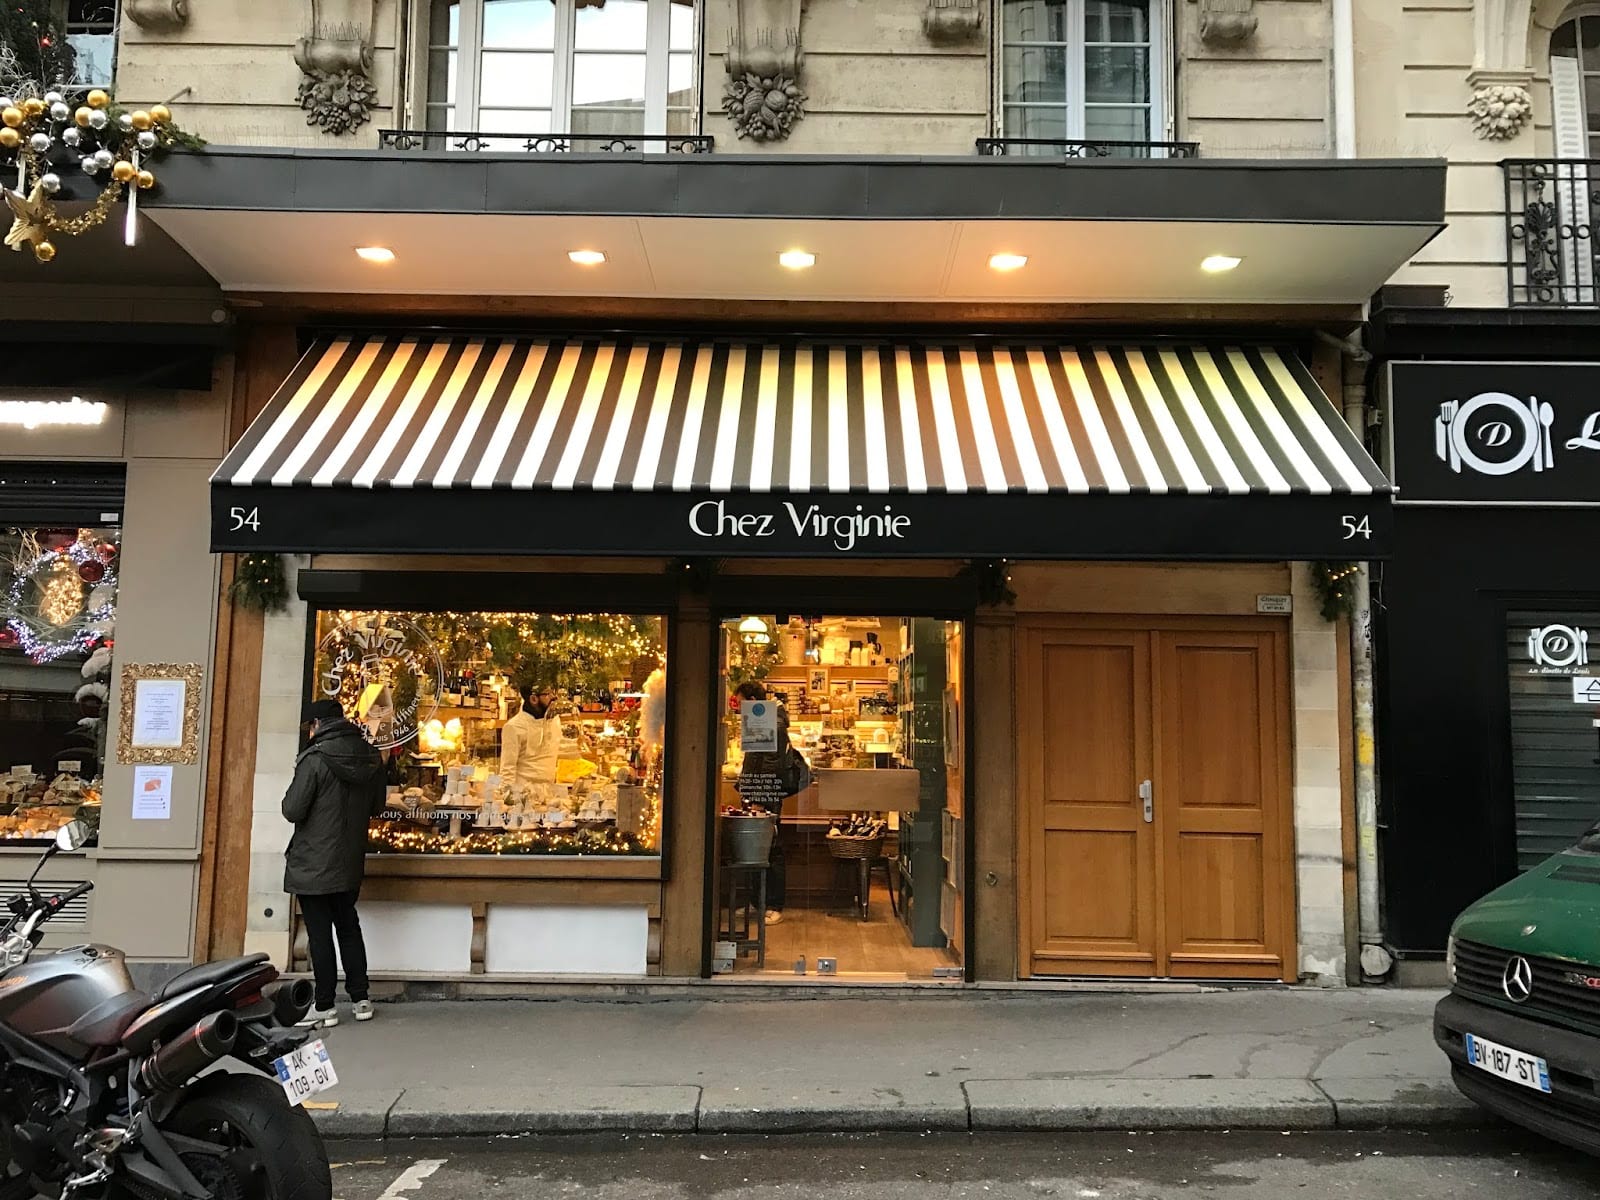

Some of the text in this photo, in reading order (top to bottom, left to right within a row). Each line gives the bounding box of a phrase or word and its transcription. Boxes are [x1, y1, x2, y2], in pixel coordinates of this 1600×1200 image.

[1478, 421, 1512, 447] D
[229, 506, 261, 532] 54
[688, 499, 911, 551] Chez Virginie
[1342, 514, 1373, 540] 54
[321, 644, 355, 696] Chez
[405, 807, 449, 820] affinons
[452, 809, 471, 820] nos
